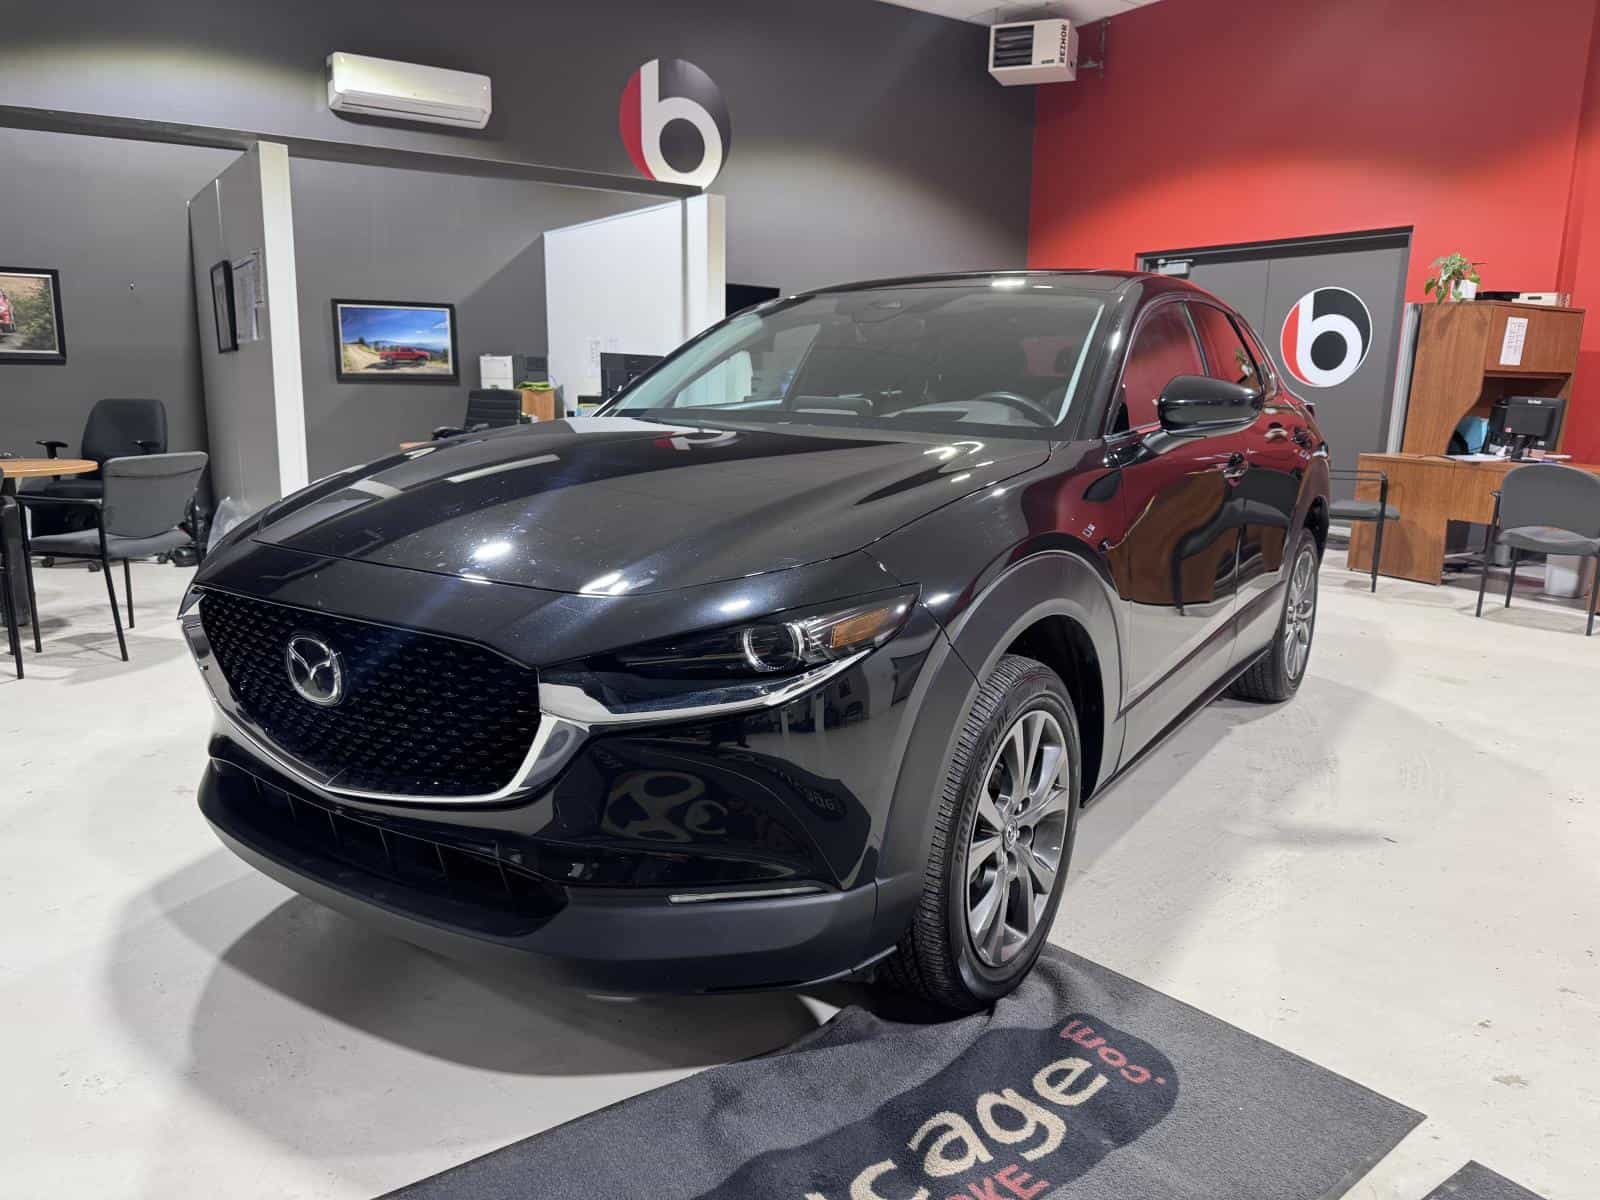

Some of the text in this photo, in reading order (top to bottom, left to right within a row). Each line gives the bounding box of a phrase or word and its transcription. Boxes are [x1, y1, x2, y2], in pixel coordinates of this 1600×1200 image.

[639, 58, 723, 190] b
[1295, 290, 1364, 387] b
[804, 1056, 1108, 1200] cage
[945, 1163, 1050, 1200] KE
